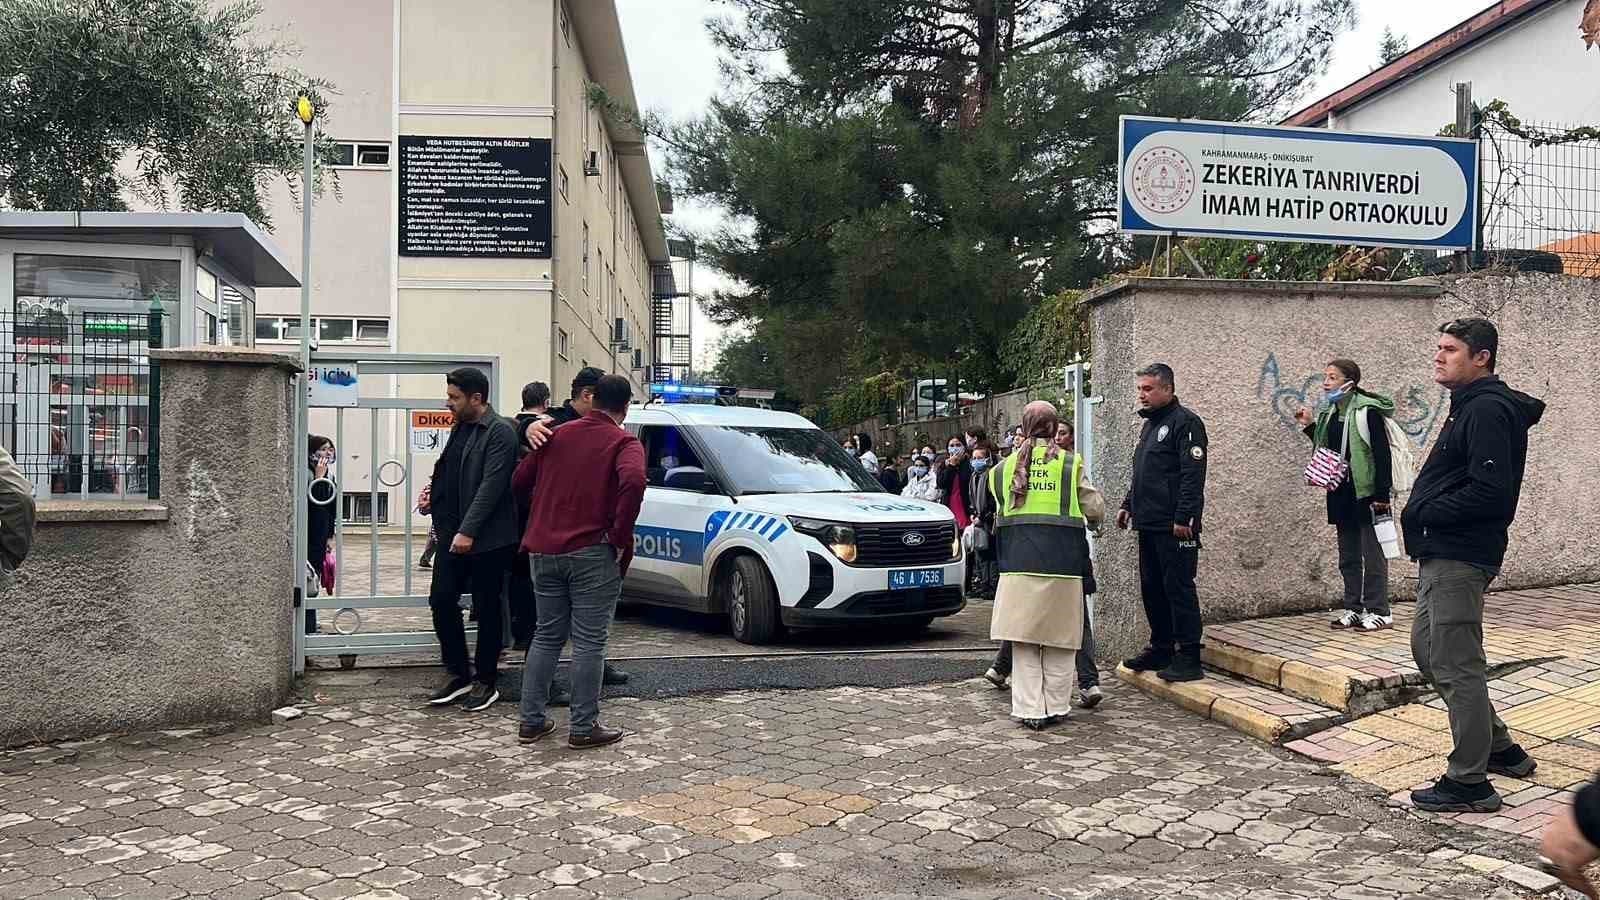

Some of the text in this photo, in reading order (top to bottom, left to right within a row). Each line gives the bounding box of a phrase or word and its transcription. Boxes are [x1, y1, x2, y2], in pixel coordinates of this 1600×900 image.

[1201, 149, 1268, 161] KAHRAMANMARAŞ
[1202, 163, 1298, 189] ZEKERİYA
[1302, 170, 1420, 195] TANRIVERDİ
[1202, 190, 1448, 226] İMAM HATİP ORTAOKULU
[418, 411, 457, 426] DİKKA
[633, 531, 681, 558] POLİS
[893, 570, 940, 585] 46 A 7536
